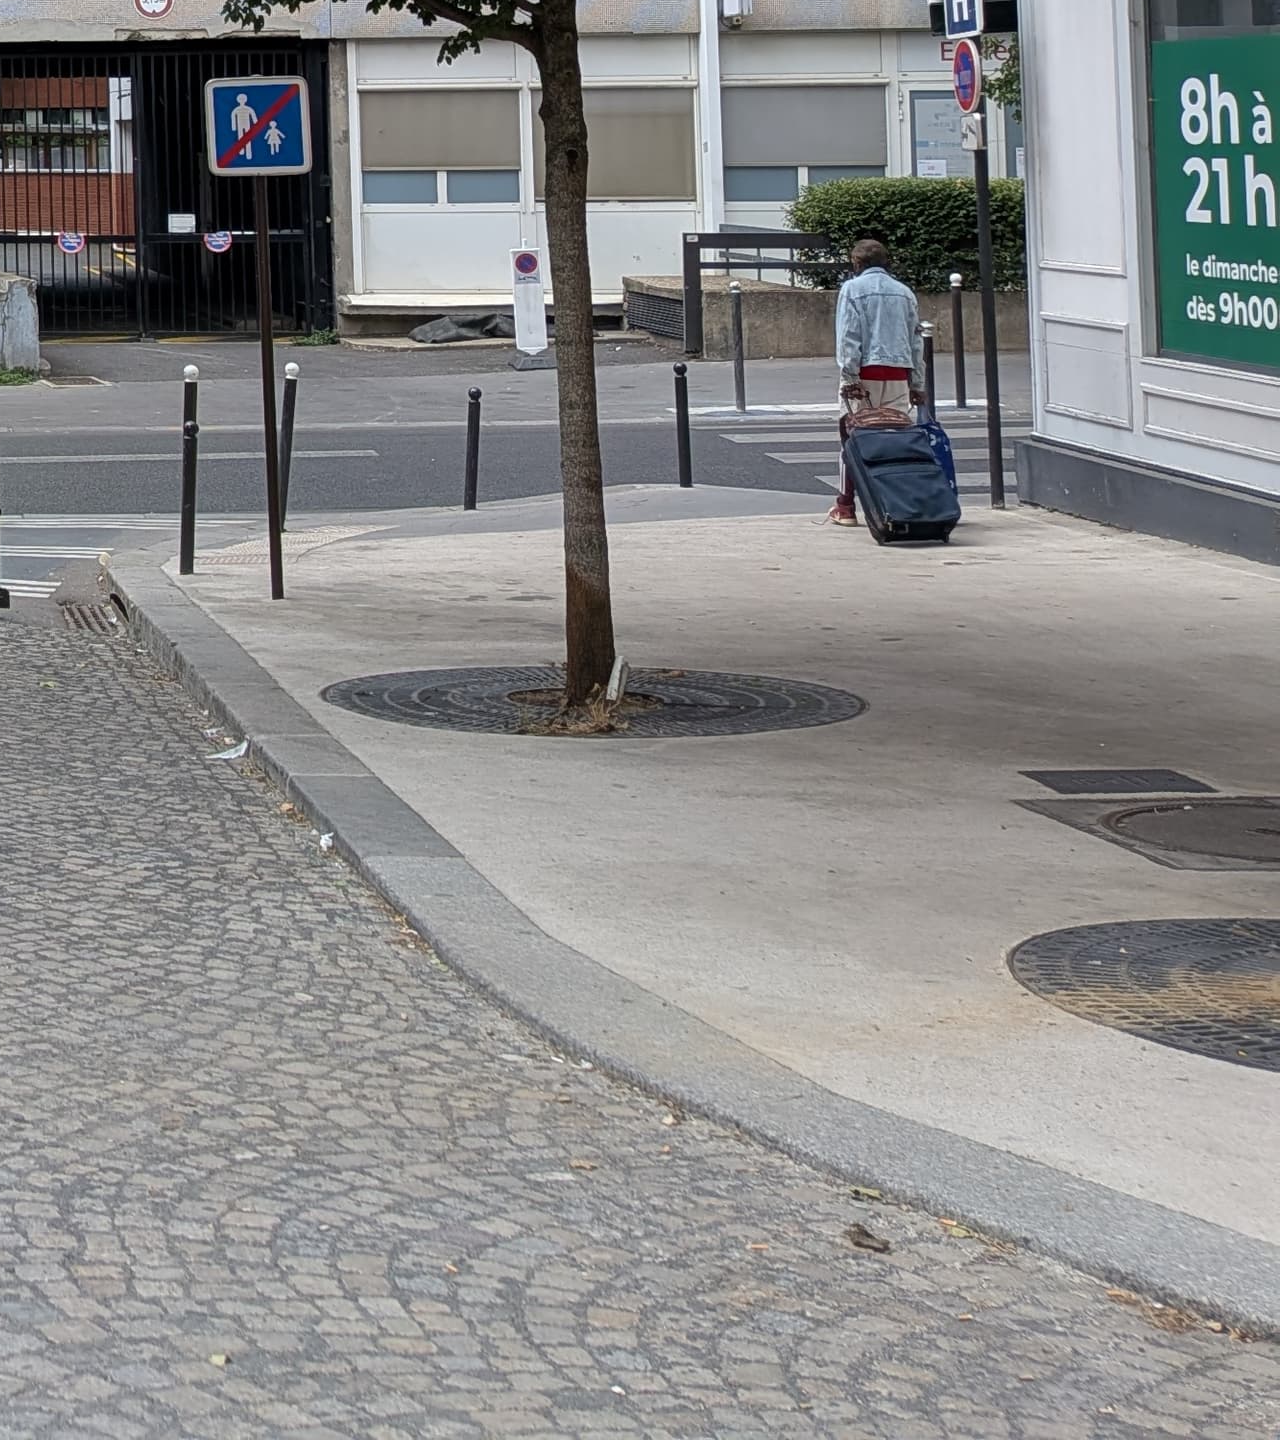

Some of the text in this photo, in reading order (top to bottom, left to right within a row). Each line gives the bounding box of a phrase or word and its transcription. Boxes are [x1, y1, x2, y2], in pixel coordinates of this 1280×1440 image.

[1181, 74, 1273, 145] 8h à
[1183, 154, 1277, 228] 21 h
[1186, 253, 1278, 283] le dimanche
[1186, 292, 1279, 330] dès 9h00
